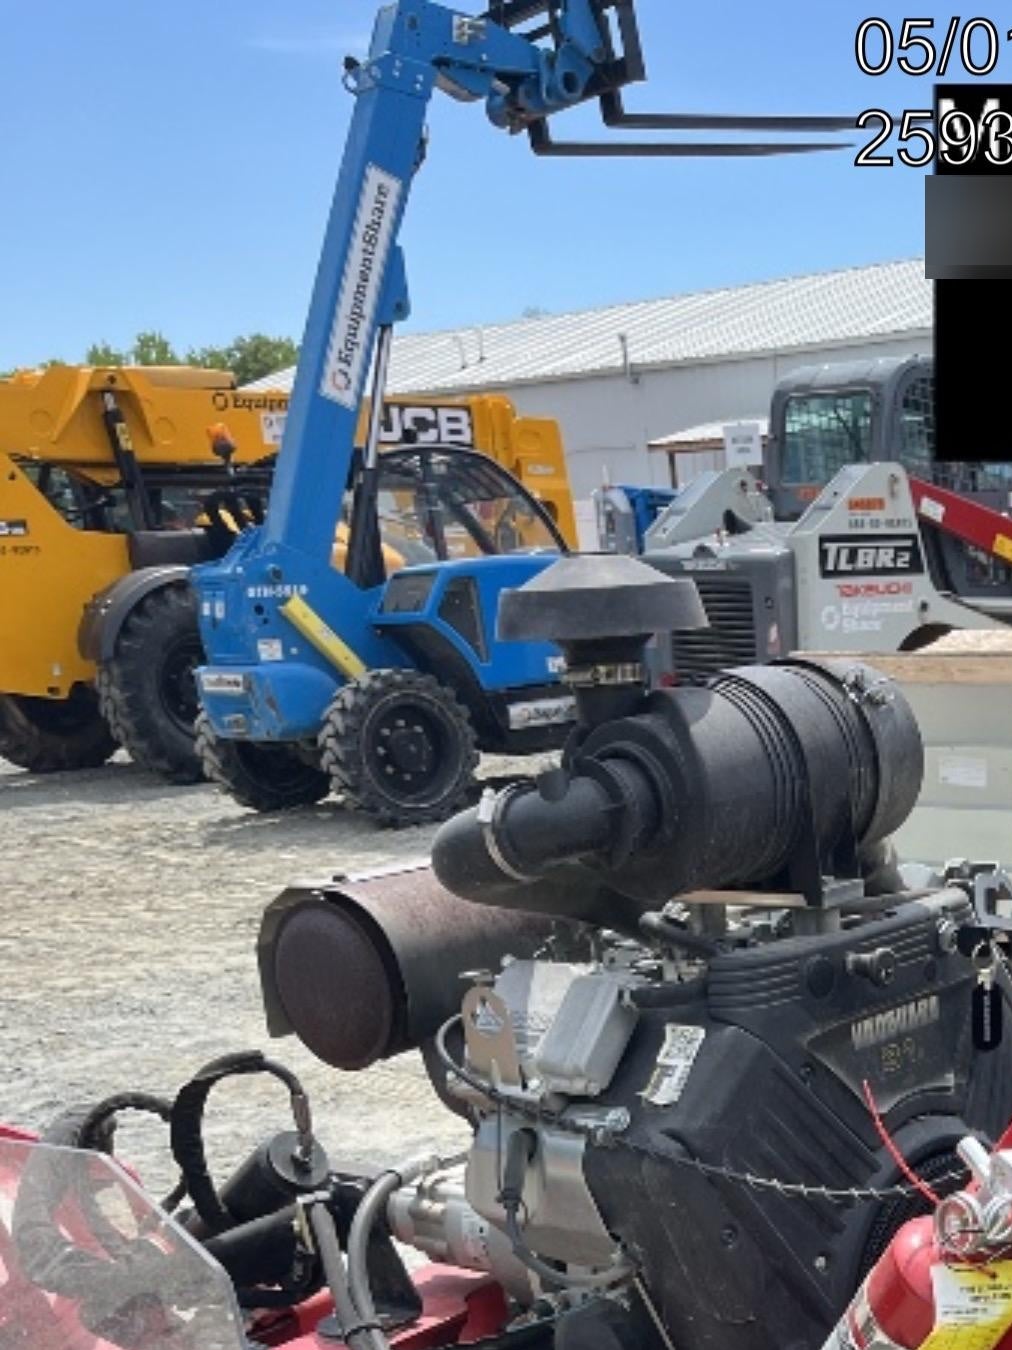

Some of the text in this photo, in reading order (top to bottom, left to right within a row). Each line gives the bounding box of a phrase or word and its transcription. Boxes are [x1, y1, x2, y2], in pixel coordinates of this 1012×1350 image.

[337, 182, 391, 367] EquipmentShare
[378, 405, 473, 442] JCB
[821, 540, 913, 571] TLBR2
